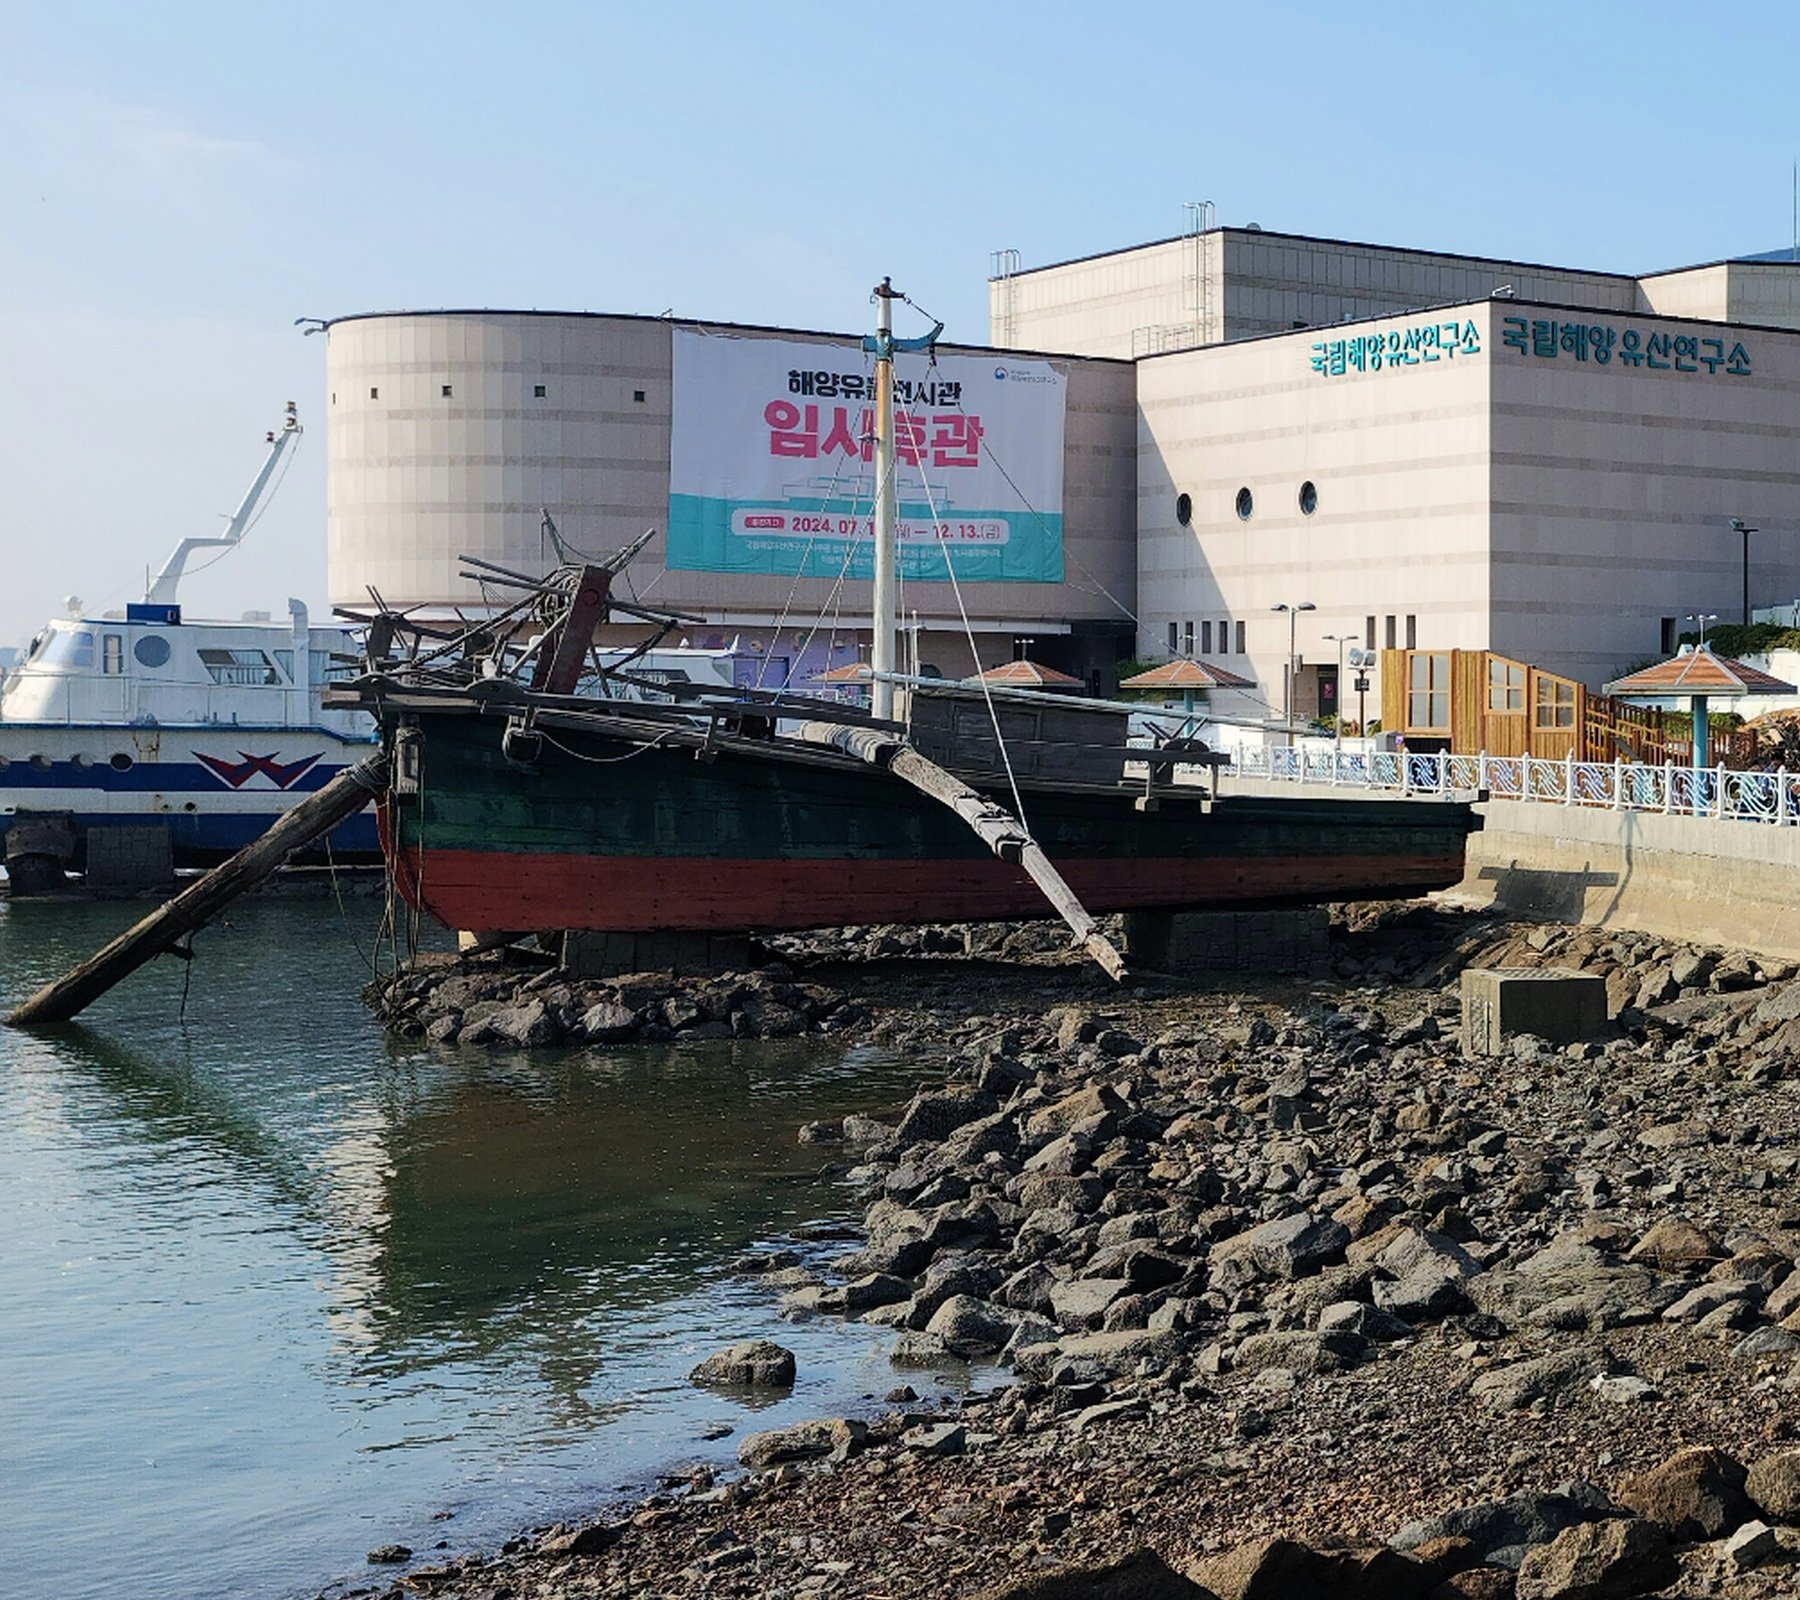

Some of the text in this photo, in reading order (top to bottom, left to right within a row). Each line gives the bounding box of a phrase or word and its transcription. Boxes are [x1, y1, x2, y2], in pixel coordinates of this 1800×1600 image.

[1310, 318, 1481, 377] 국립해양유산연구소
[1502, 316, 1753, 376] 국립해양유산연구소
[764, 400, 984, 467] 임시휴관
[792, 517, 835, 533] 2024.
